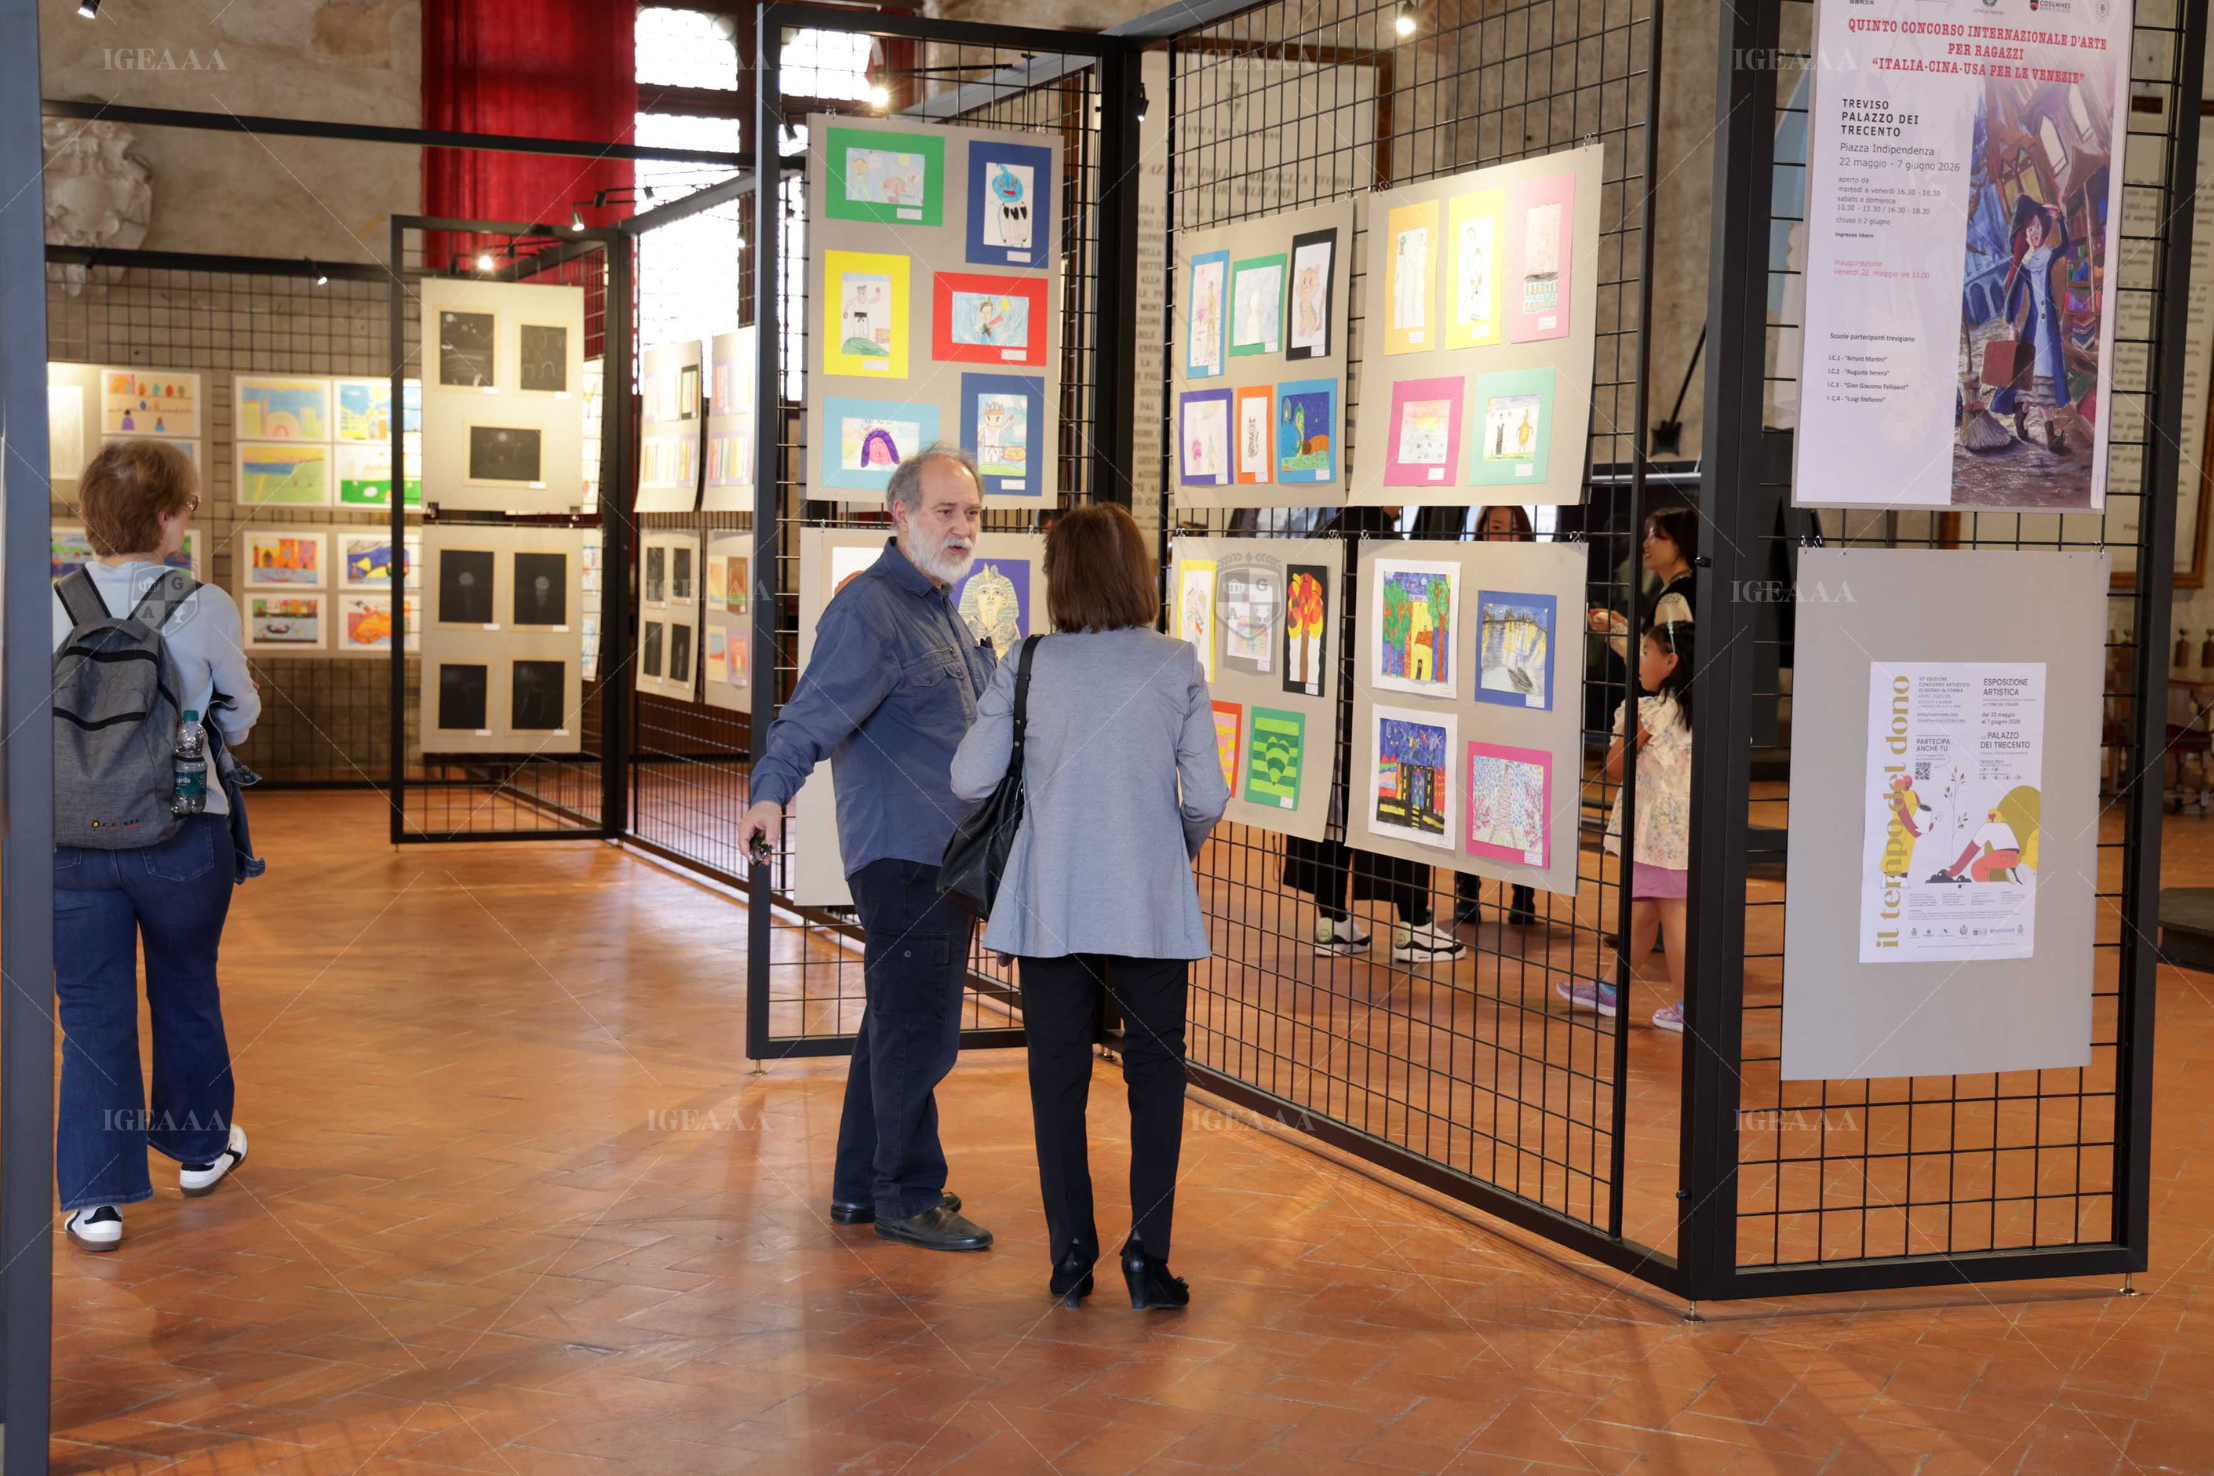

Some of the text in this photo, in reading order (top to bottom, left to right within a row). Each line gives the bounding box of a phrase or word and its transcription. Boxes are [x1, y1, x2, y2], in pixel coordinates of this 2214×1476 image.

[2040, 0, 2071, 8] COSUMNES
[1848, 18, 2107, 50] QUINTO CONCORSO INTERNAZIONALE D'ARTE
[1948, 43, 2024, 60] PER RAGAZZI
[1990, 64, 2011, 78] PER
[2015, 68, 2028, 80] LE
[1842, 99, 1889, 110] TREVISO
[1842, 112, 1919, 125] PALAZZO DEI
[1841, 125, 1900, 137] TRECENTO
[1840, 143, 1934, 156] Piazza Indipendenza
[1839, 158, 1850, 166] 22
[1854, 159, 1887, 169] maggio
[1897, 160, 1902, 168] 7
[1906, 161, 1936, 171] giugno
[1938, 162, 1960, 172] 2026
[1897, 188, 1915, 196] 16.30
[1983, 688, 2019, 696] ARTISTICA
[1876, 675, 1910, 948] il tempo del dono
